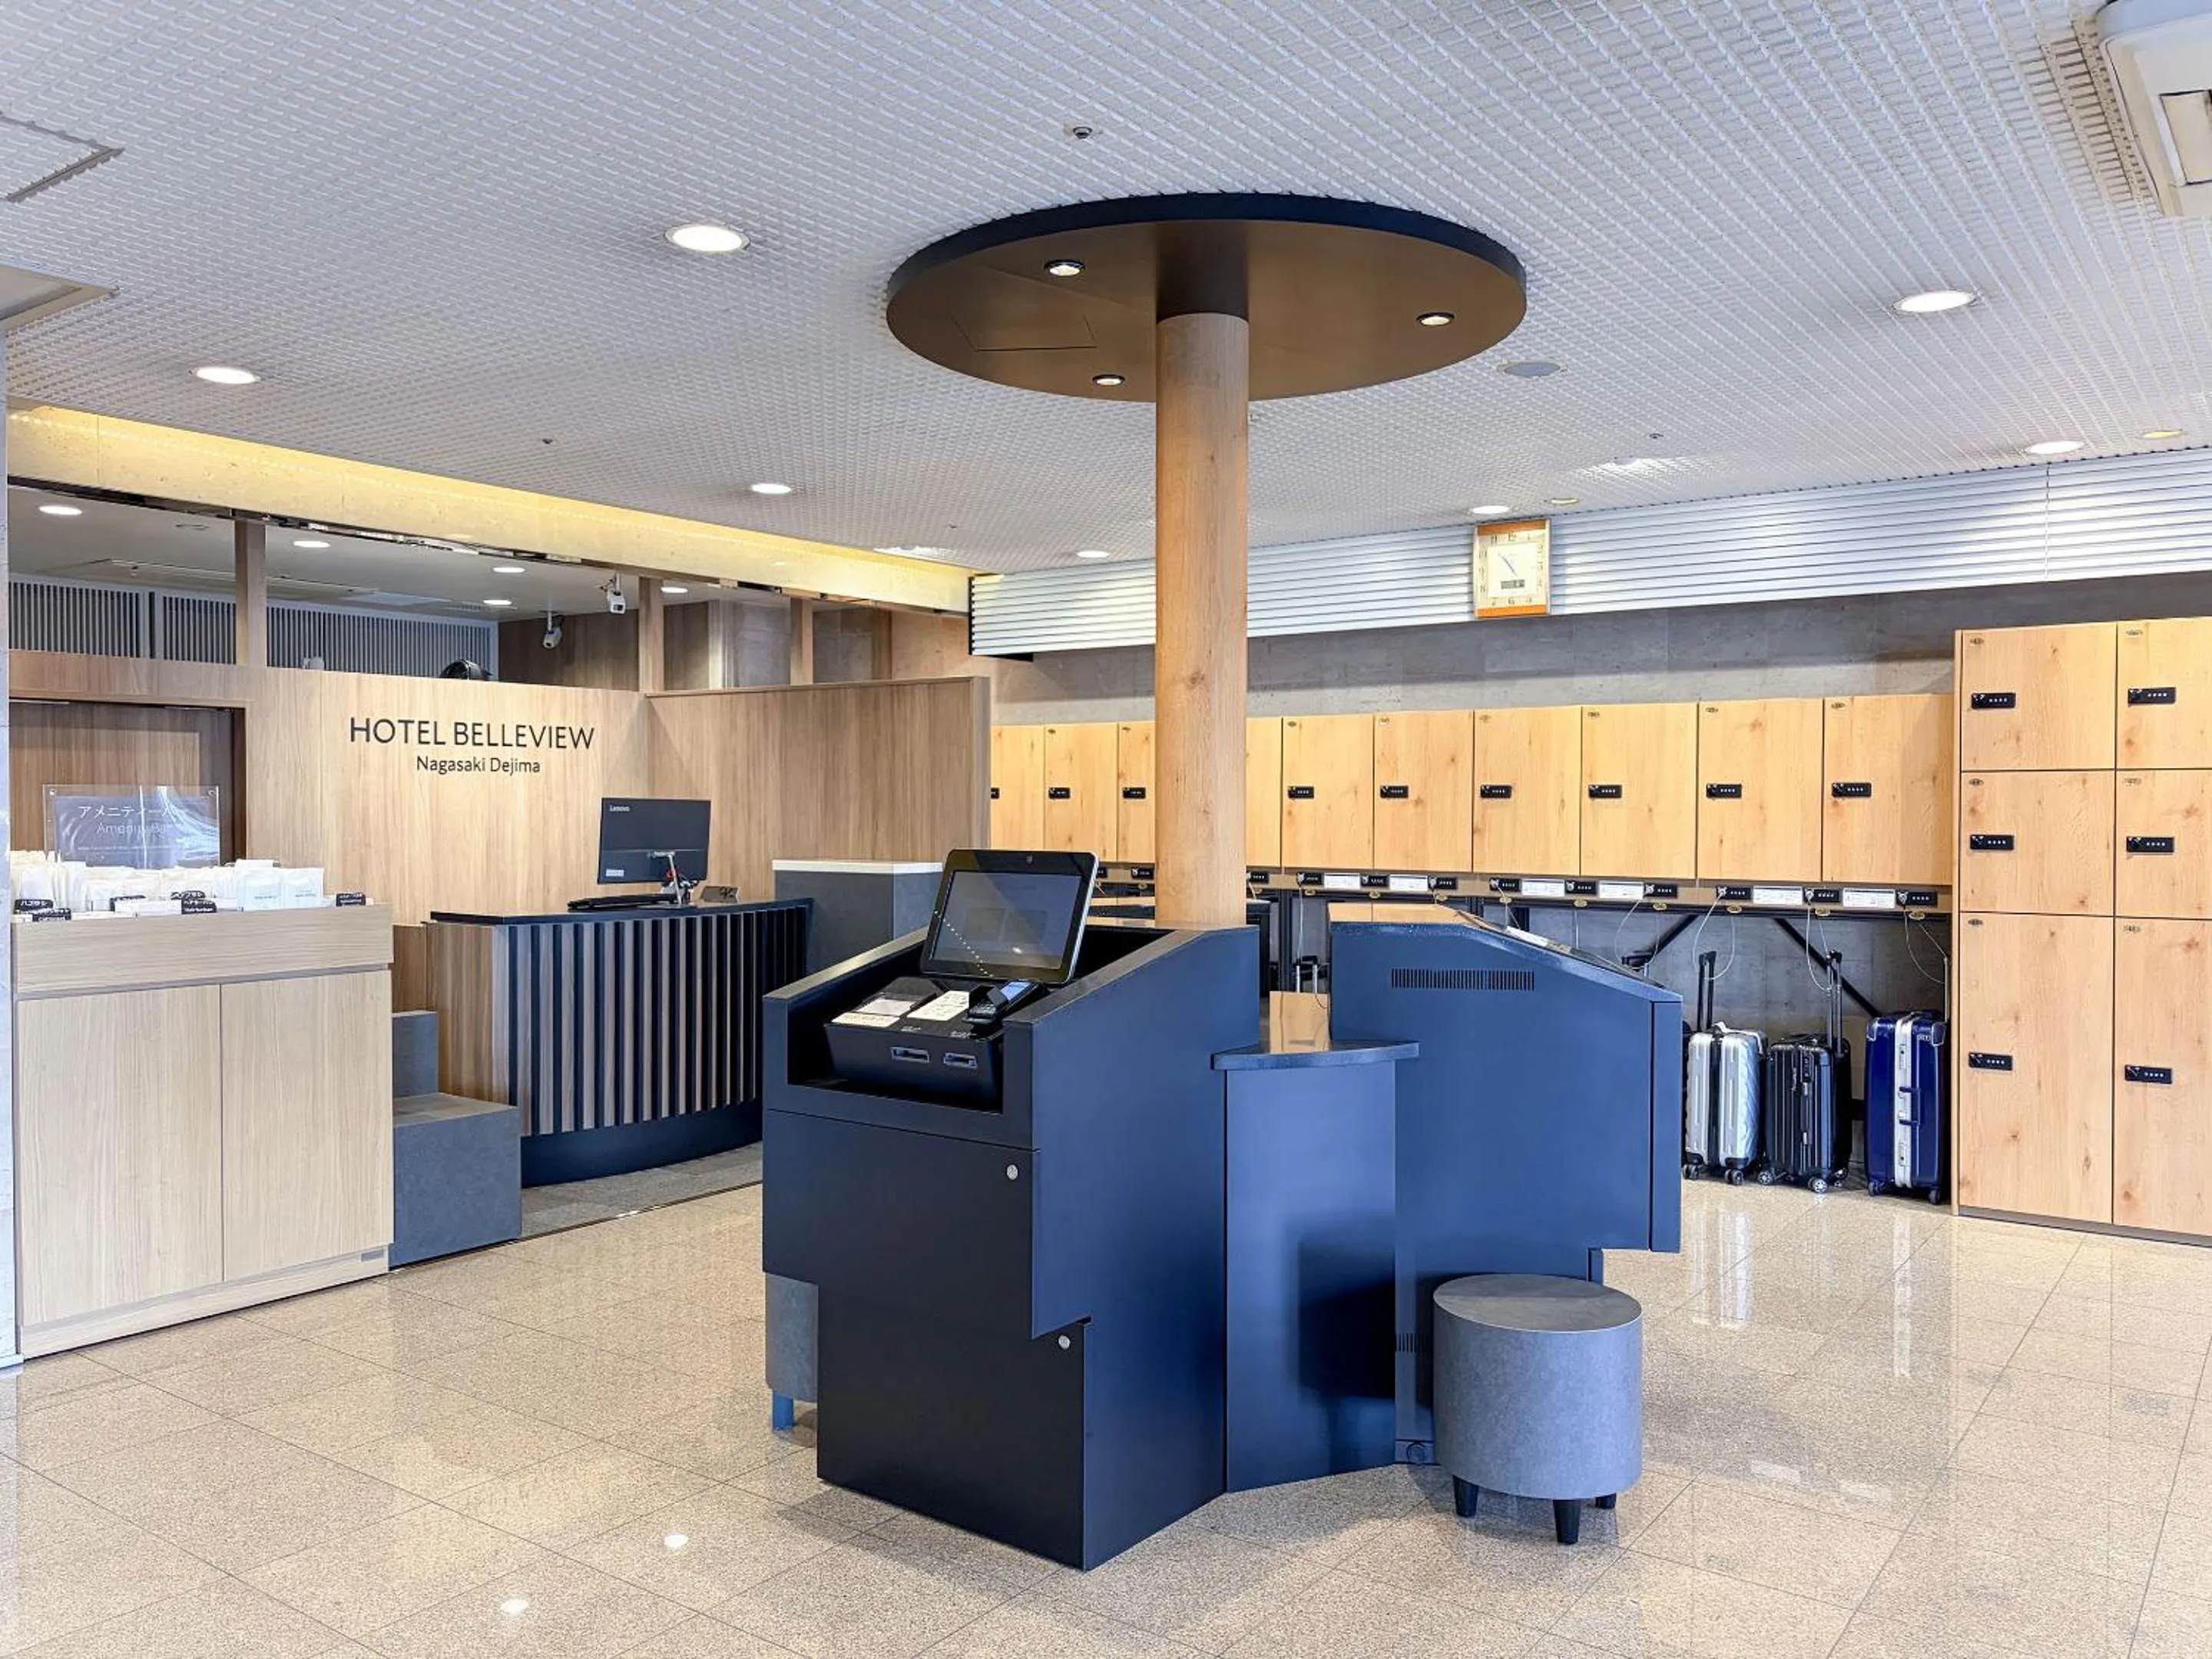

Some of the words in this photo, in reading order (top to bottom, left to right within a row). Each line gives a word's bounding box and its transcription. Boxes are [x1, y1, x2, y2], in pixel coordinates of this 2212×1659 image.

[350, 717, 446, 744] HOTEL
[453, 721, 595, 750] BELLEVIEW
[416, 755, 486, 774] Nagasaki
[490, 757, 541, 777] Dejima
